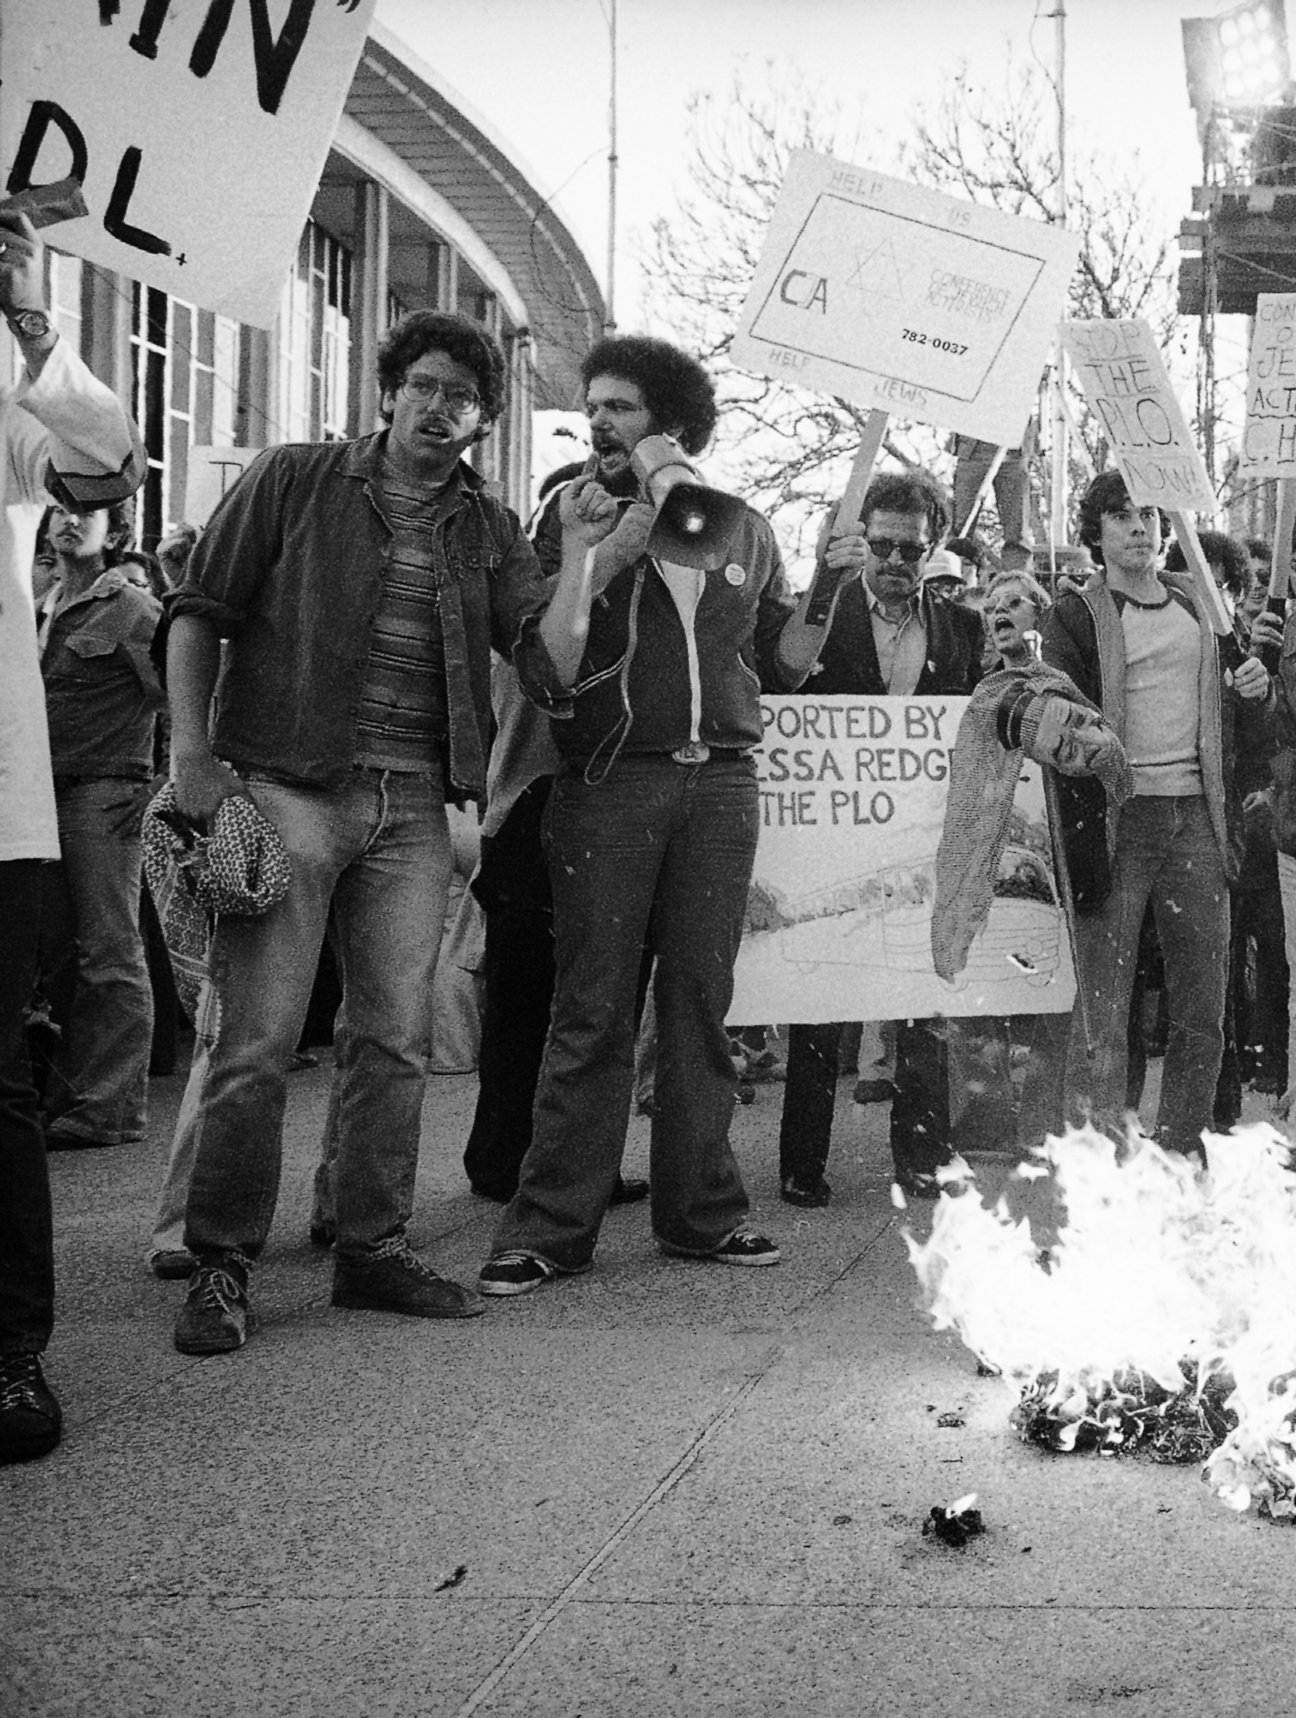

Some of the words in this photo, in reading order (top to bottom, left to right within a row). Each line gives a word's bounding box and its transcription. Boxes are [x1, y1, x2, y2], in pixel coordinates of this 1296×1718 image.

[830, 170, 884, 196] HELP
[901, 329, 968, 356] 782-0037
[769, 349, 811, 370] HELP
[874, 378, 927, 406] JEWS
[1084, 360, 1156, 394] THE
[1096, 397, 1180, 448] P.L.O.
[1122, 457, 1204, 499] NOW!
[904, 705, 947, 740] BY
[856, 748, 953, 782] REDG
[760, 791, 817, 826] THE
[831, 790, 894, 826] PLO
